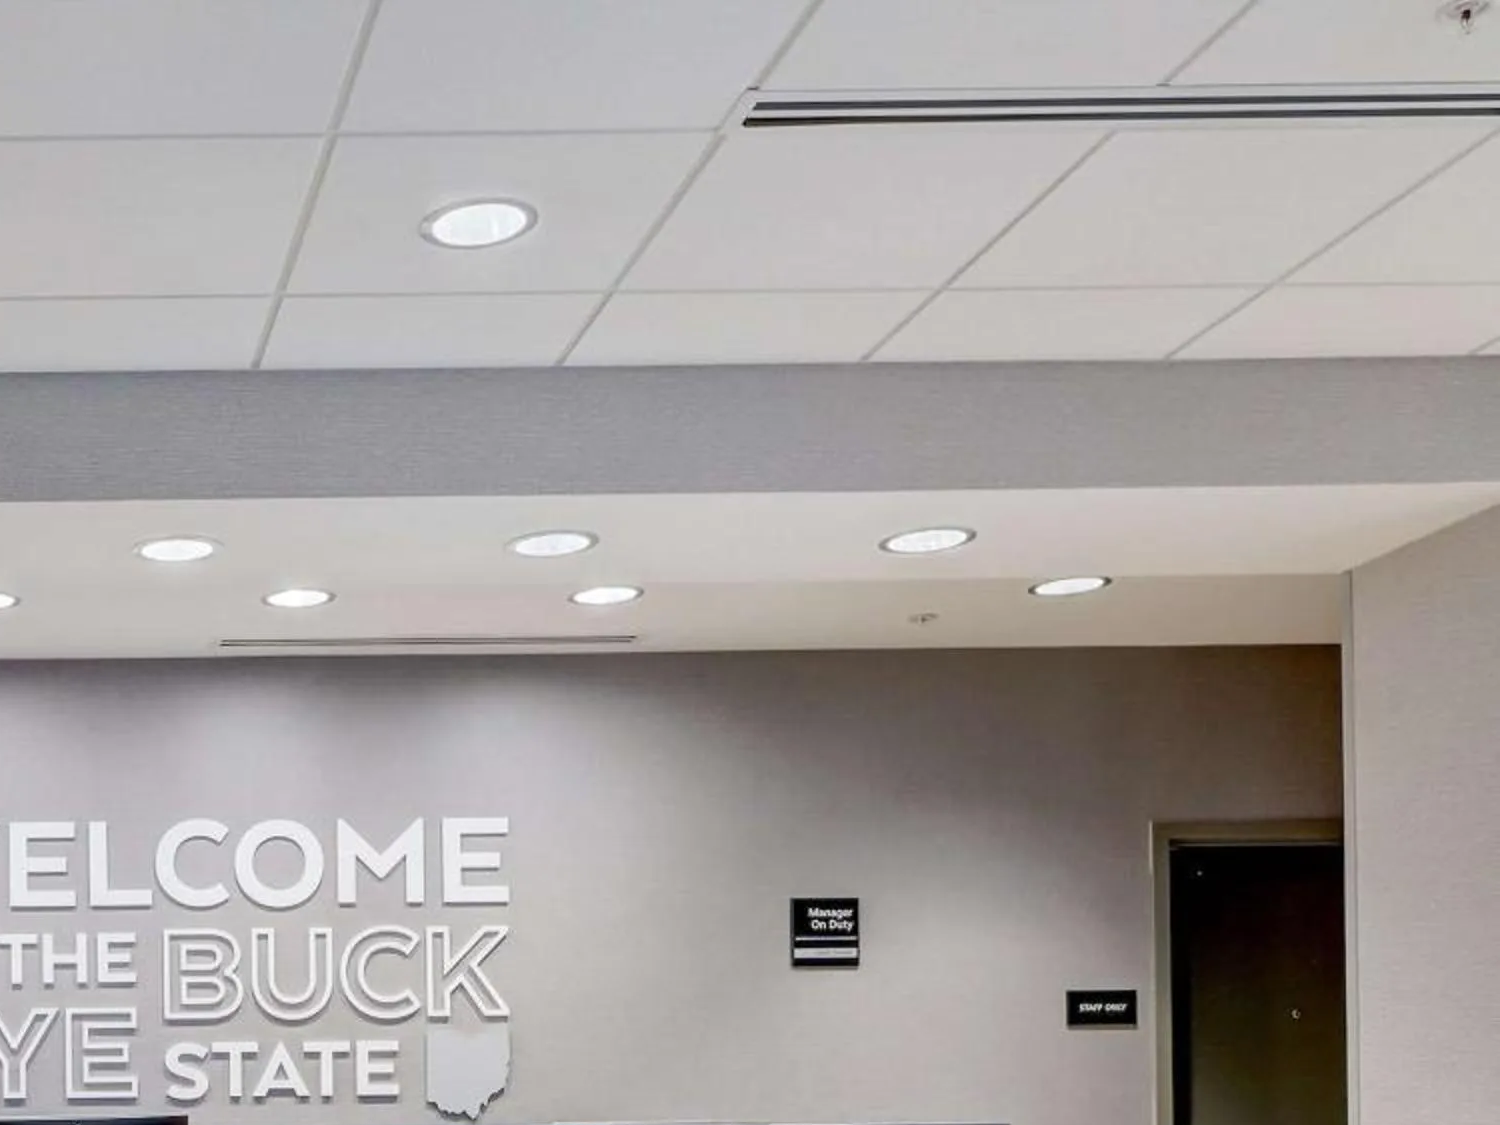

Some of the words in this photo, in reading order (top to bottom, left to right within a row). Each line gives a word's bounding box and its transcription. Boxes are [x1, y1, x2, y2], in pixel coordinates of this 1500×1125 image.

[807, 907, 854, 920] Manager
[811, 919, 827, 930] On
[829, 919, 854, 932] Duty
[162, 926, 510, 1021] BUCK
[1079, 1003, 1103, 1012] STAFF
[1105, 1003, 1127, 1011] ONLY
[164, 1040, 400, 1103] STATE
